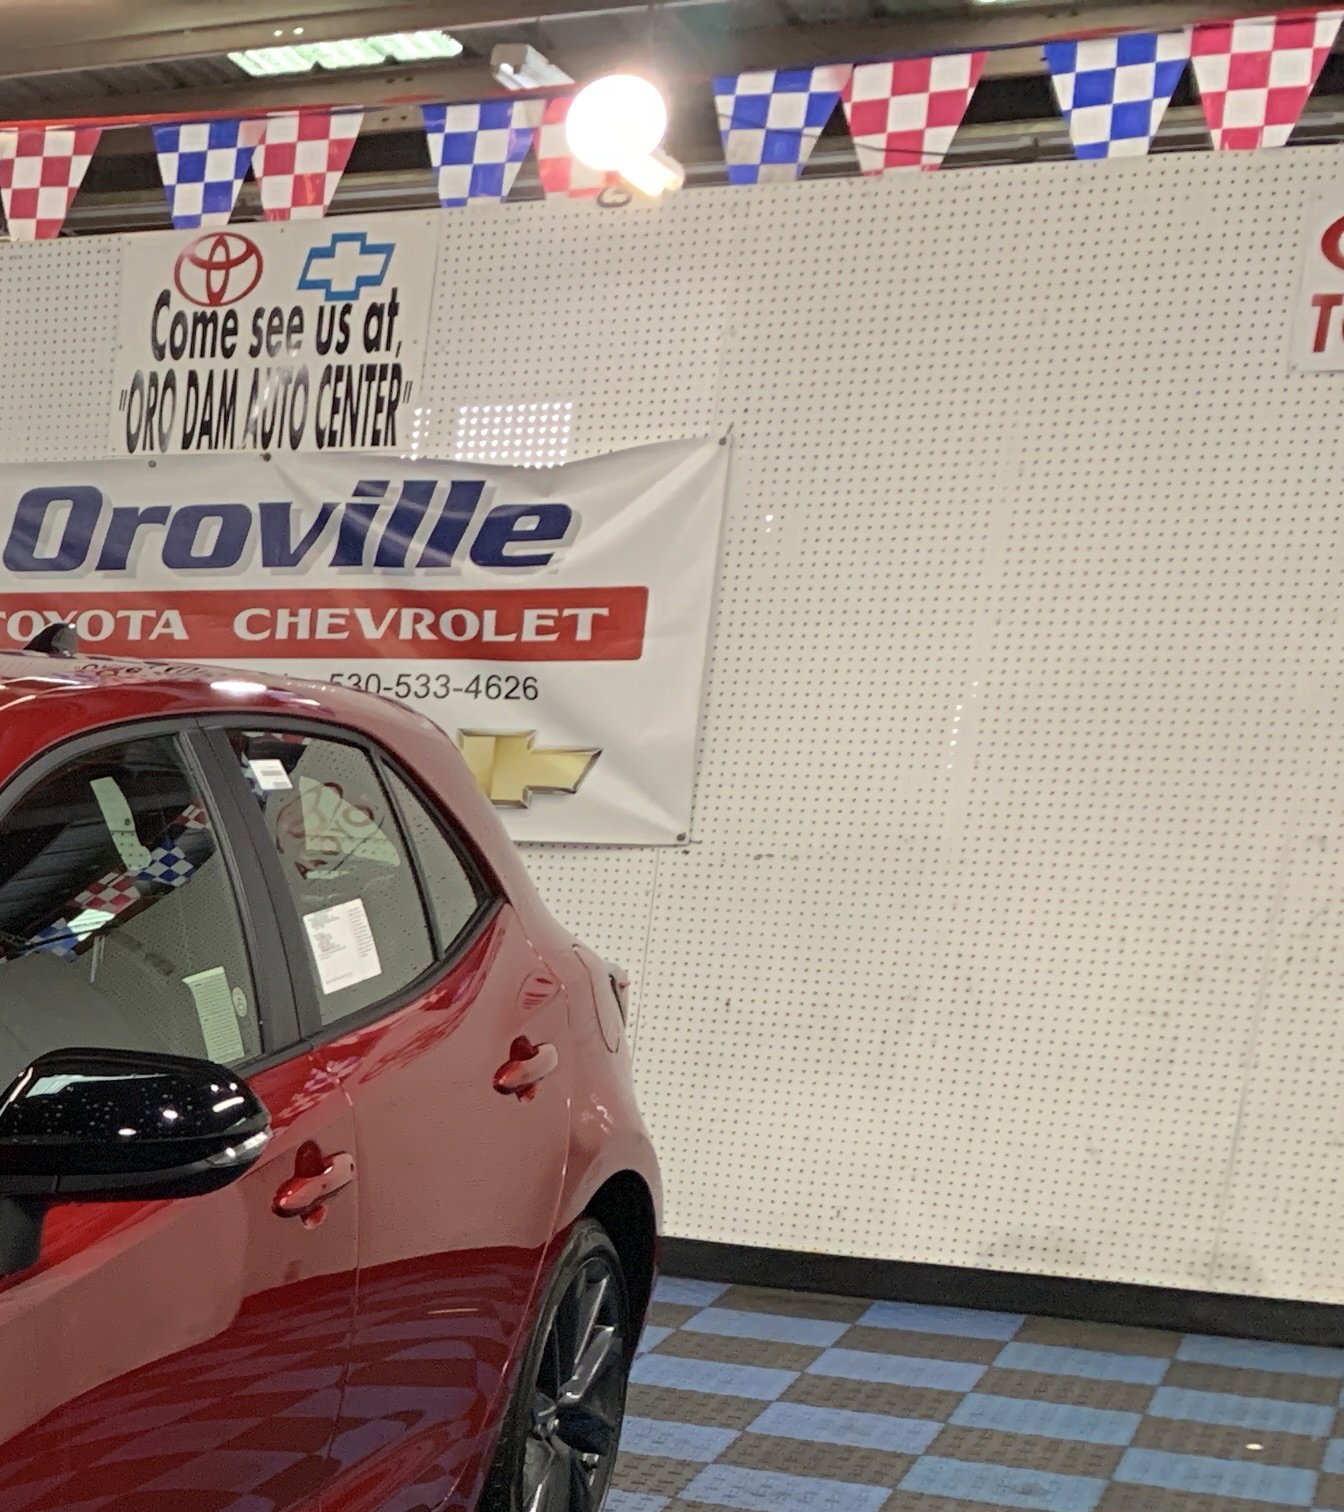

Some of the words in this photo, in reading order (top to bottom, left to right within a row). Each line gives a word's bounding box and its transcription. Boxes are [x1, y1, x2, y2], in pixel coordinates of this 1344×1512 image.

[151, 288, 239, 362] Come
[248, 305, 305, 358] see
[315, 302, 353, 356] us
[362, 287, 403, 358] at,
[180, 368, 239, 450] DAM
[242, 363, 310, 451] AUTO
[1, 479, 574, 573] Oroville
[233, 606, 610, 643] CHEVROLET
